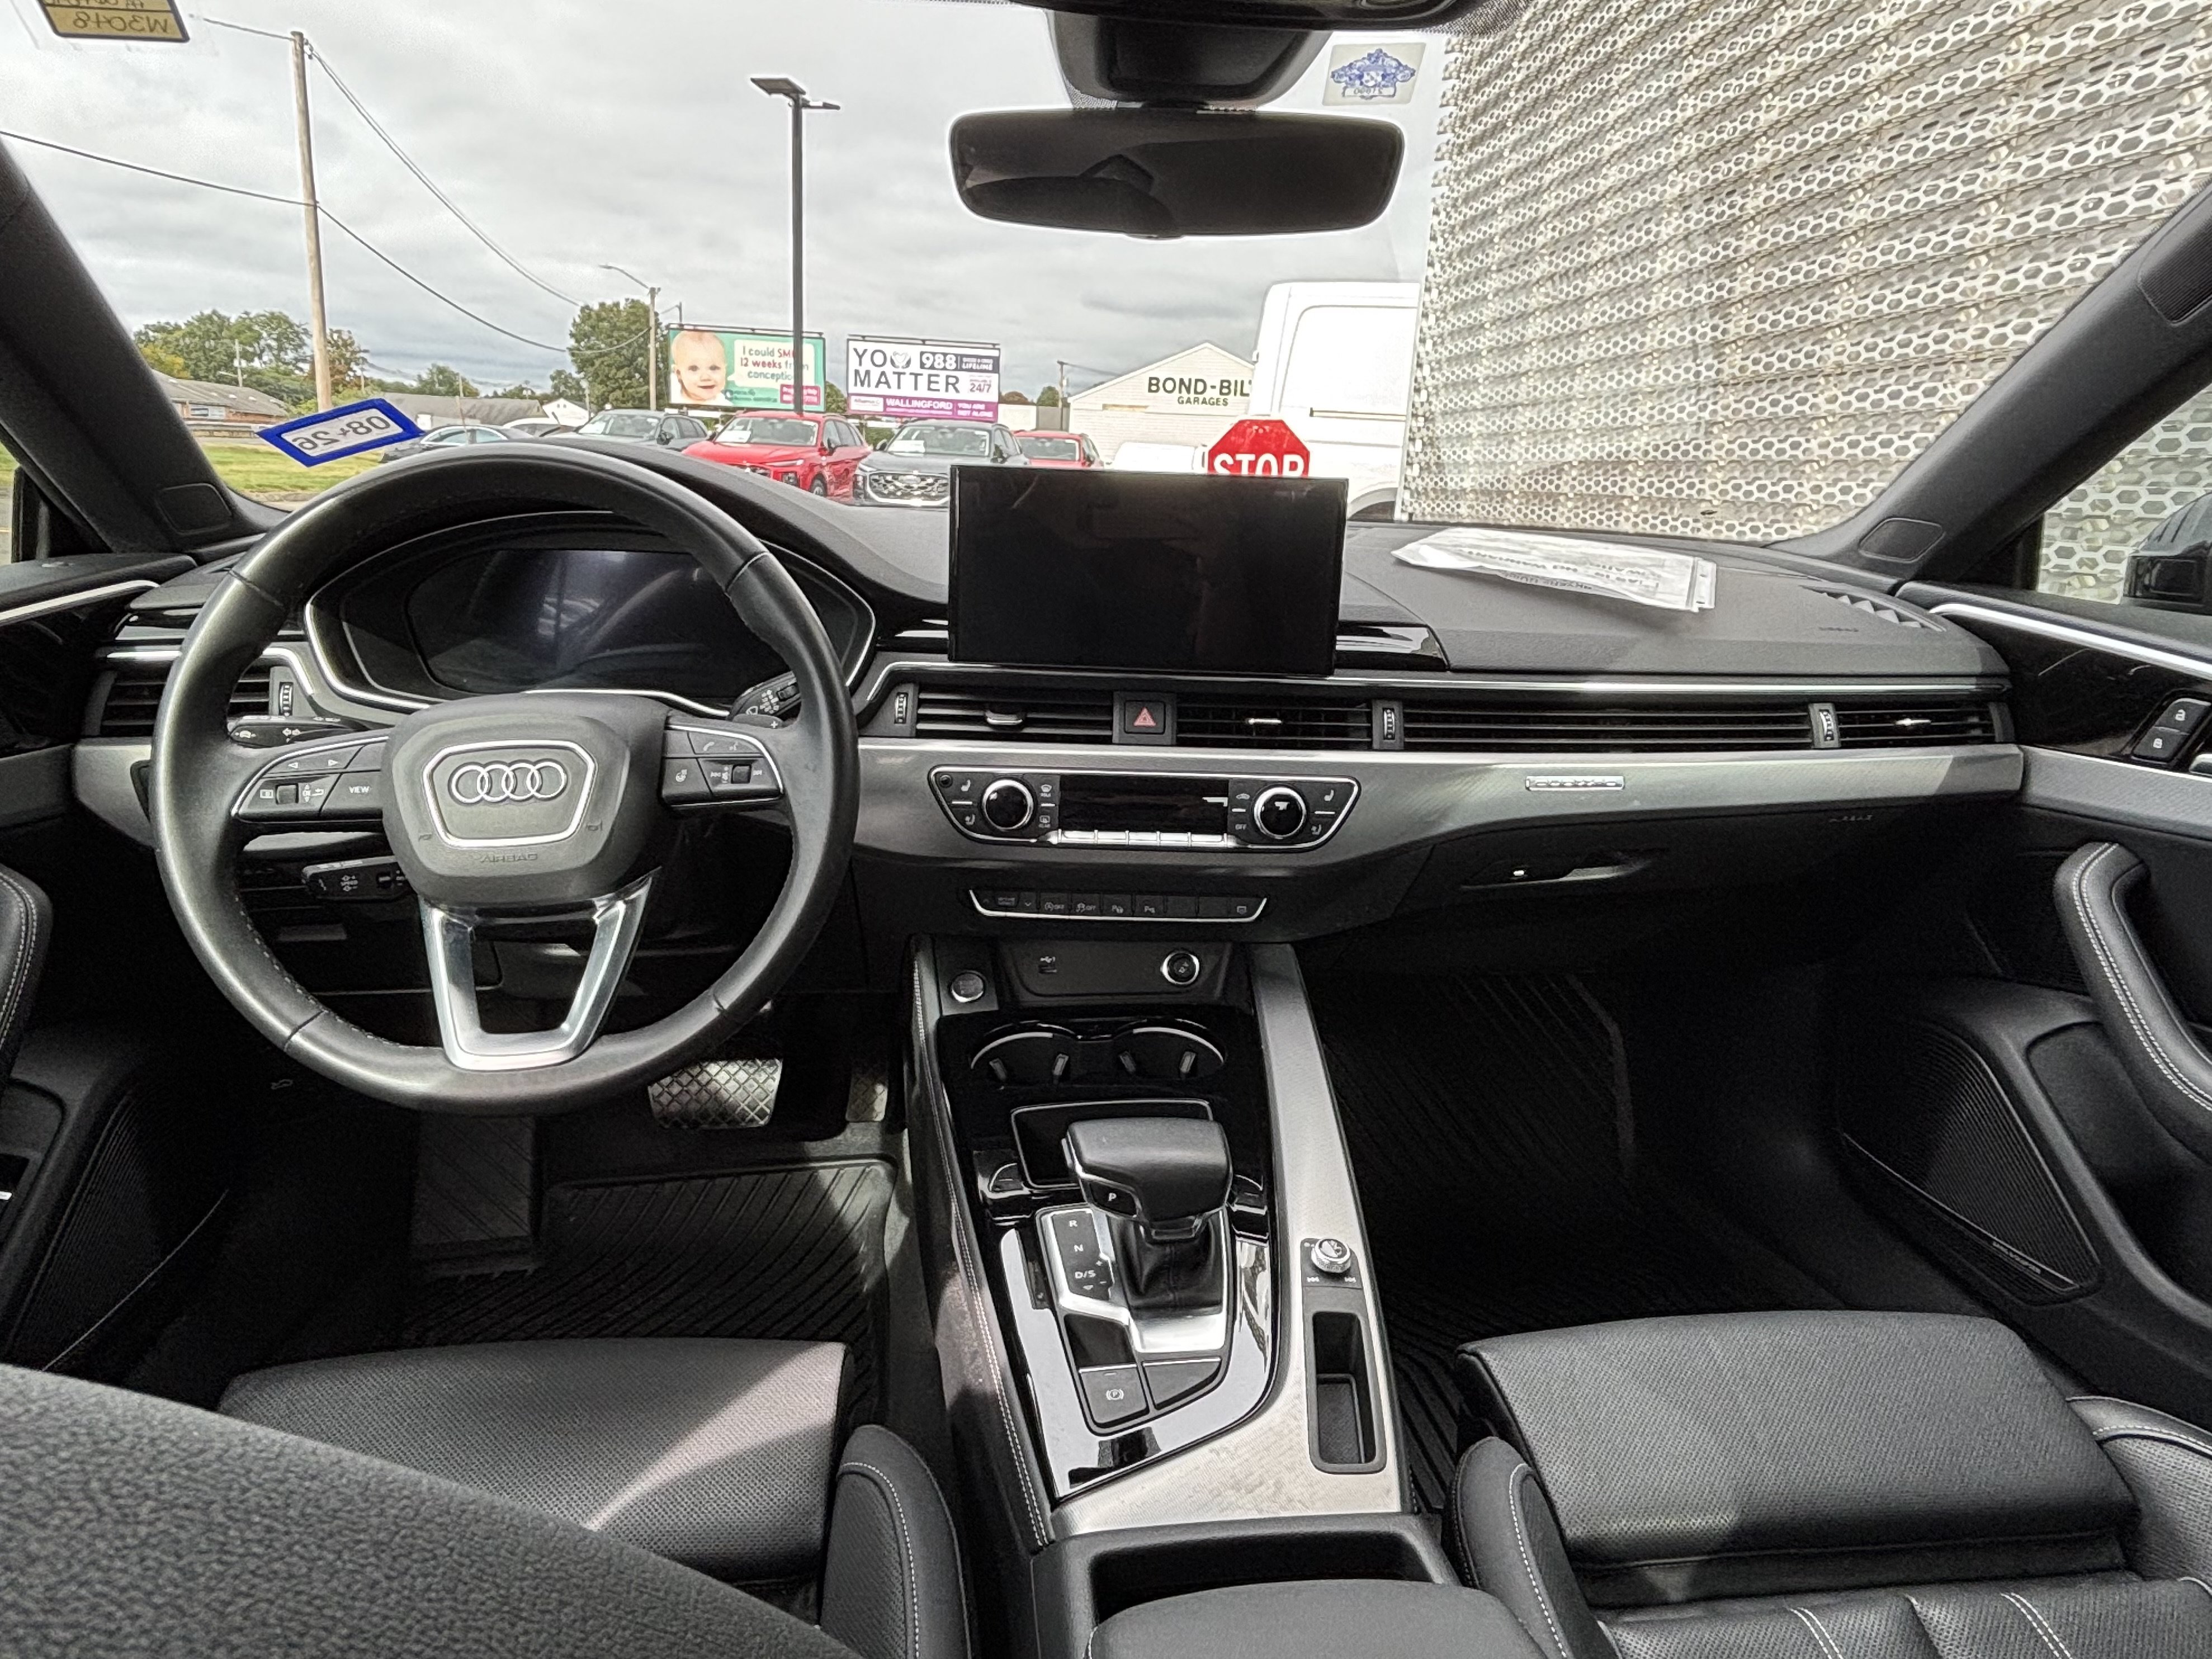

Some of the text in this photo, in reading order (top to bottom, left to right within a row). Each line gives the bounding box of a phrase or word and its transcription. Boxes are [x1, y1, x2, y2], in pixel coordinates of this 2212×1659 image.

[743, 346, 746, 355] I
[748, 347, 775, 357] could
[740, 357, 749, 367] 12
[752, 360, 782, 369] weeks
[921, 353, 957, 370] 988
[748, 370, 794, 382] conceptio
[854, 369, 960, 393] MATTER
[970, 382, 992, 393] 24/7
[1147, 377, 1252, 397] BOND-BIL
[886, 398, 953, 410] WALLINGFORD
[1177, 396, 1228, 407] GARAGES
[1213, 453, 1304, 476] STOP
[1108, 1193, 1117, 1202] P
[1075, 1270, 1096, 1279] D/S
